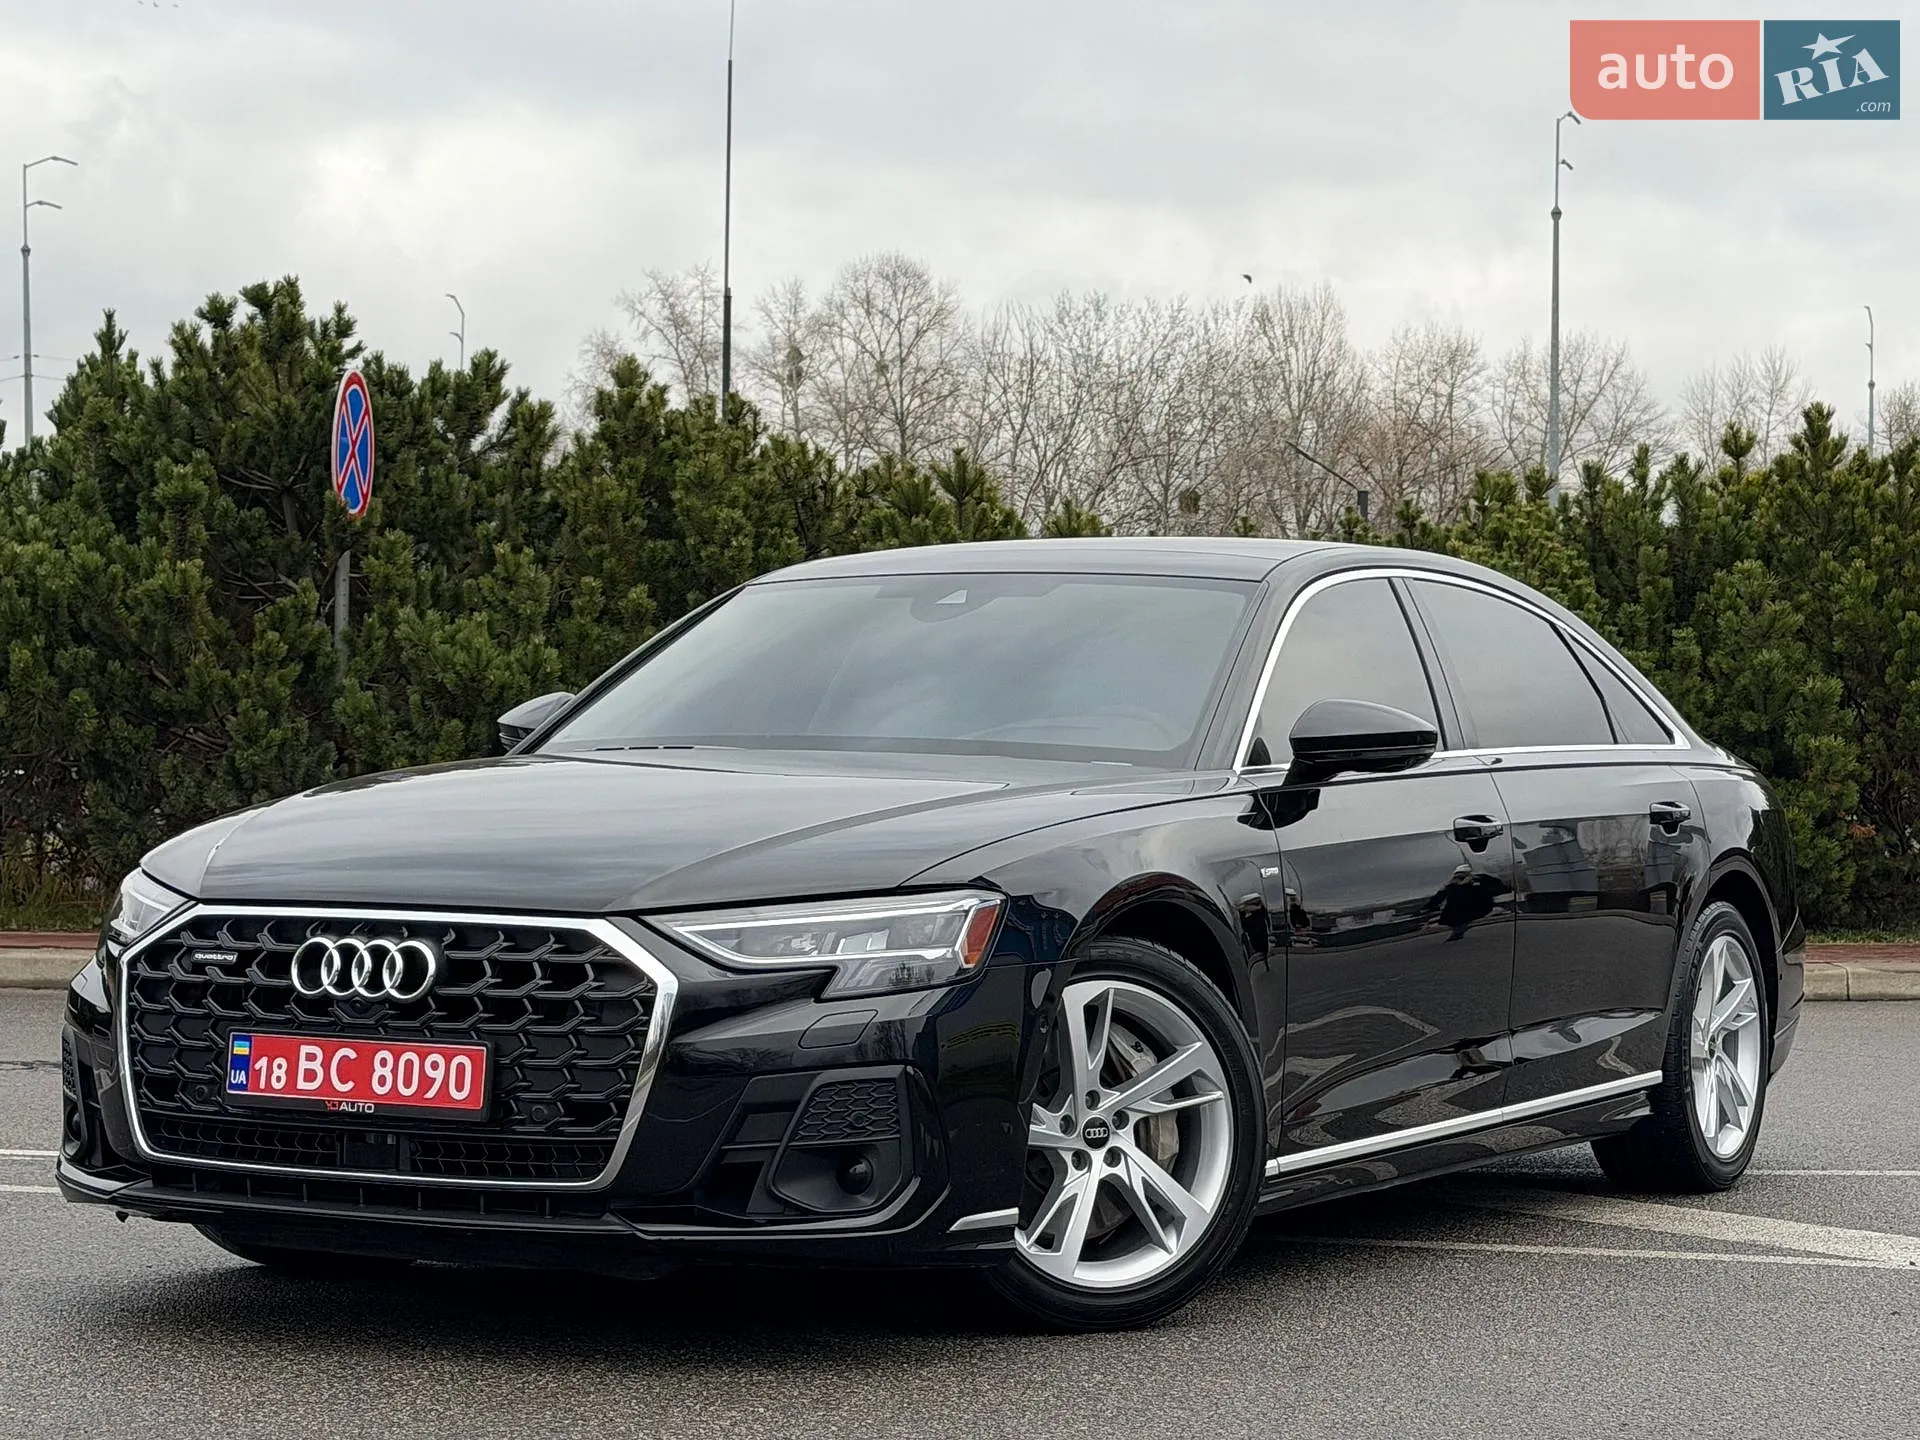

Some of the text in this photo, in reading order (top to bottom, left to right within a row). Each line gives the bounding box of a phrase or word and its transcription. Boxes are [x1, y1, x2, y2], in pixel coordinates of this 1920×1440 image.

[193, 952, 235, 962] quattro
[230, 1069, 247, 1085] UA
[254, 1044, 472, 1101] 18 BC 8090
